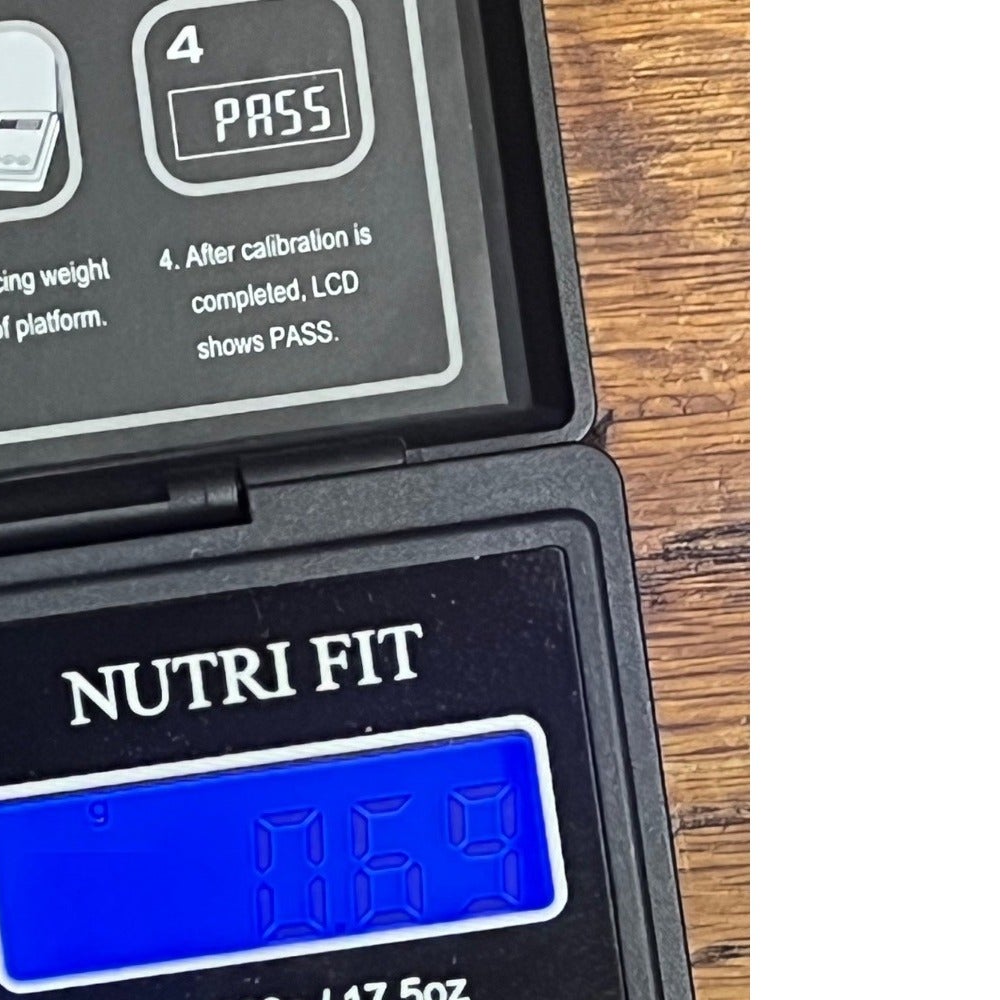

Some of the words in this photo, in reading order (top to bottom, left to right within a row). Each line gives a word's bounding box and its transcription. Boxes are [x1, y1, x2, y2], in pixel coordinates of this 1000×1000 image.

[165, 24, 203, 63] 4
[214, 85, 331, 143] PASS
[159, 249, 179, 271] 4.
[186, 242, 235, 268] After
[241, 230, 348, 260] calibration
[353, 223, 372, 246] is
[40, 257, 111, 290] weight
[191, 280, 307, 314] completed,
[311, 270, 359, 297] LCD
[15, 307, 107, 344] platform.
[196, 331, 265, 360] shows
[271, 320, 339, 349] PASS.
[61, 641, 297, 726] NUTRI
[310, 623, 423, 692] FIT
